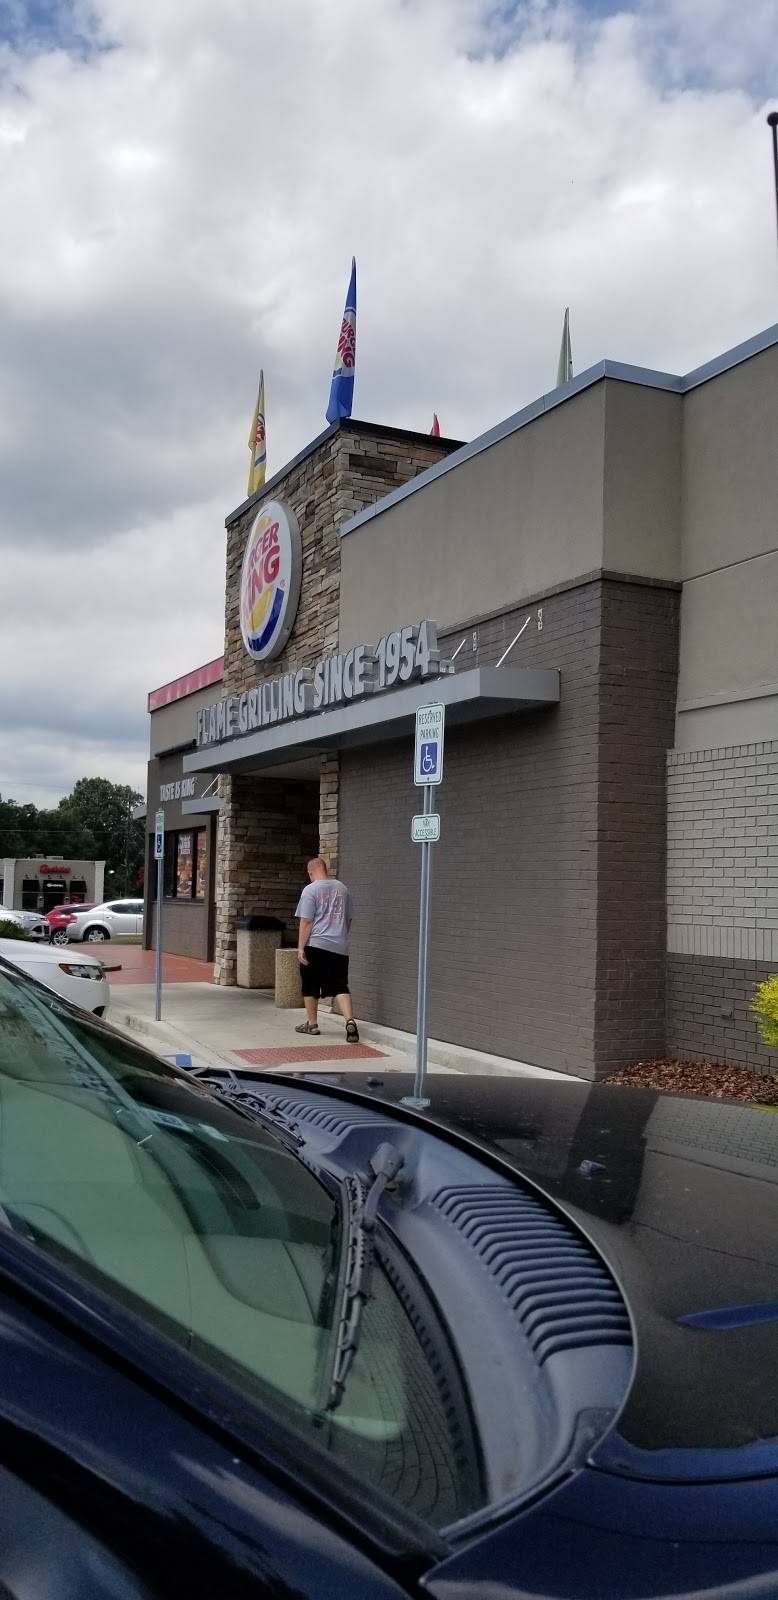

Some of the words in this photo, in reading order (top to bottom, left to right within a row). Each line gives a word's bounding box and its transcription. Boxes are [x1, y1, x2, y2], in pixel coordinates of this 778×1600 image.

[197, 697, 236, 746] FLAME
[239, 668, 307, 731] GRILLING
[314, 645, 369, 707] SINCE
[418, 710, 442, 725] RESERVED
[419, 727, 440, 741] PARKING
[159, 782, 175, 802] TASTE
